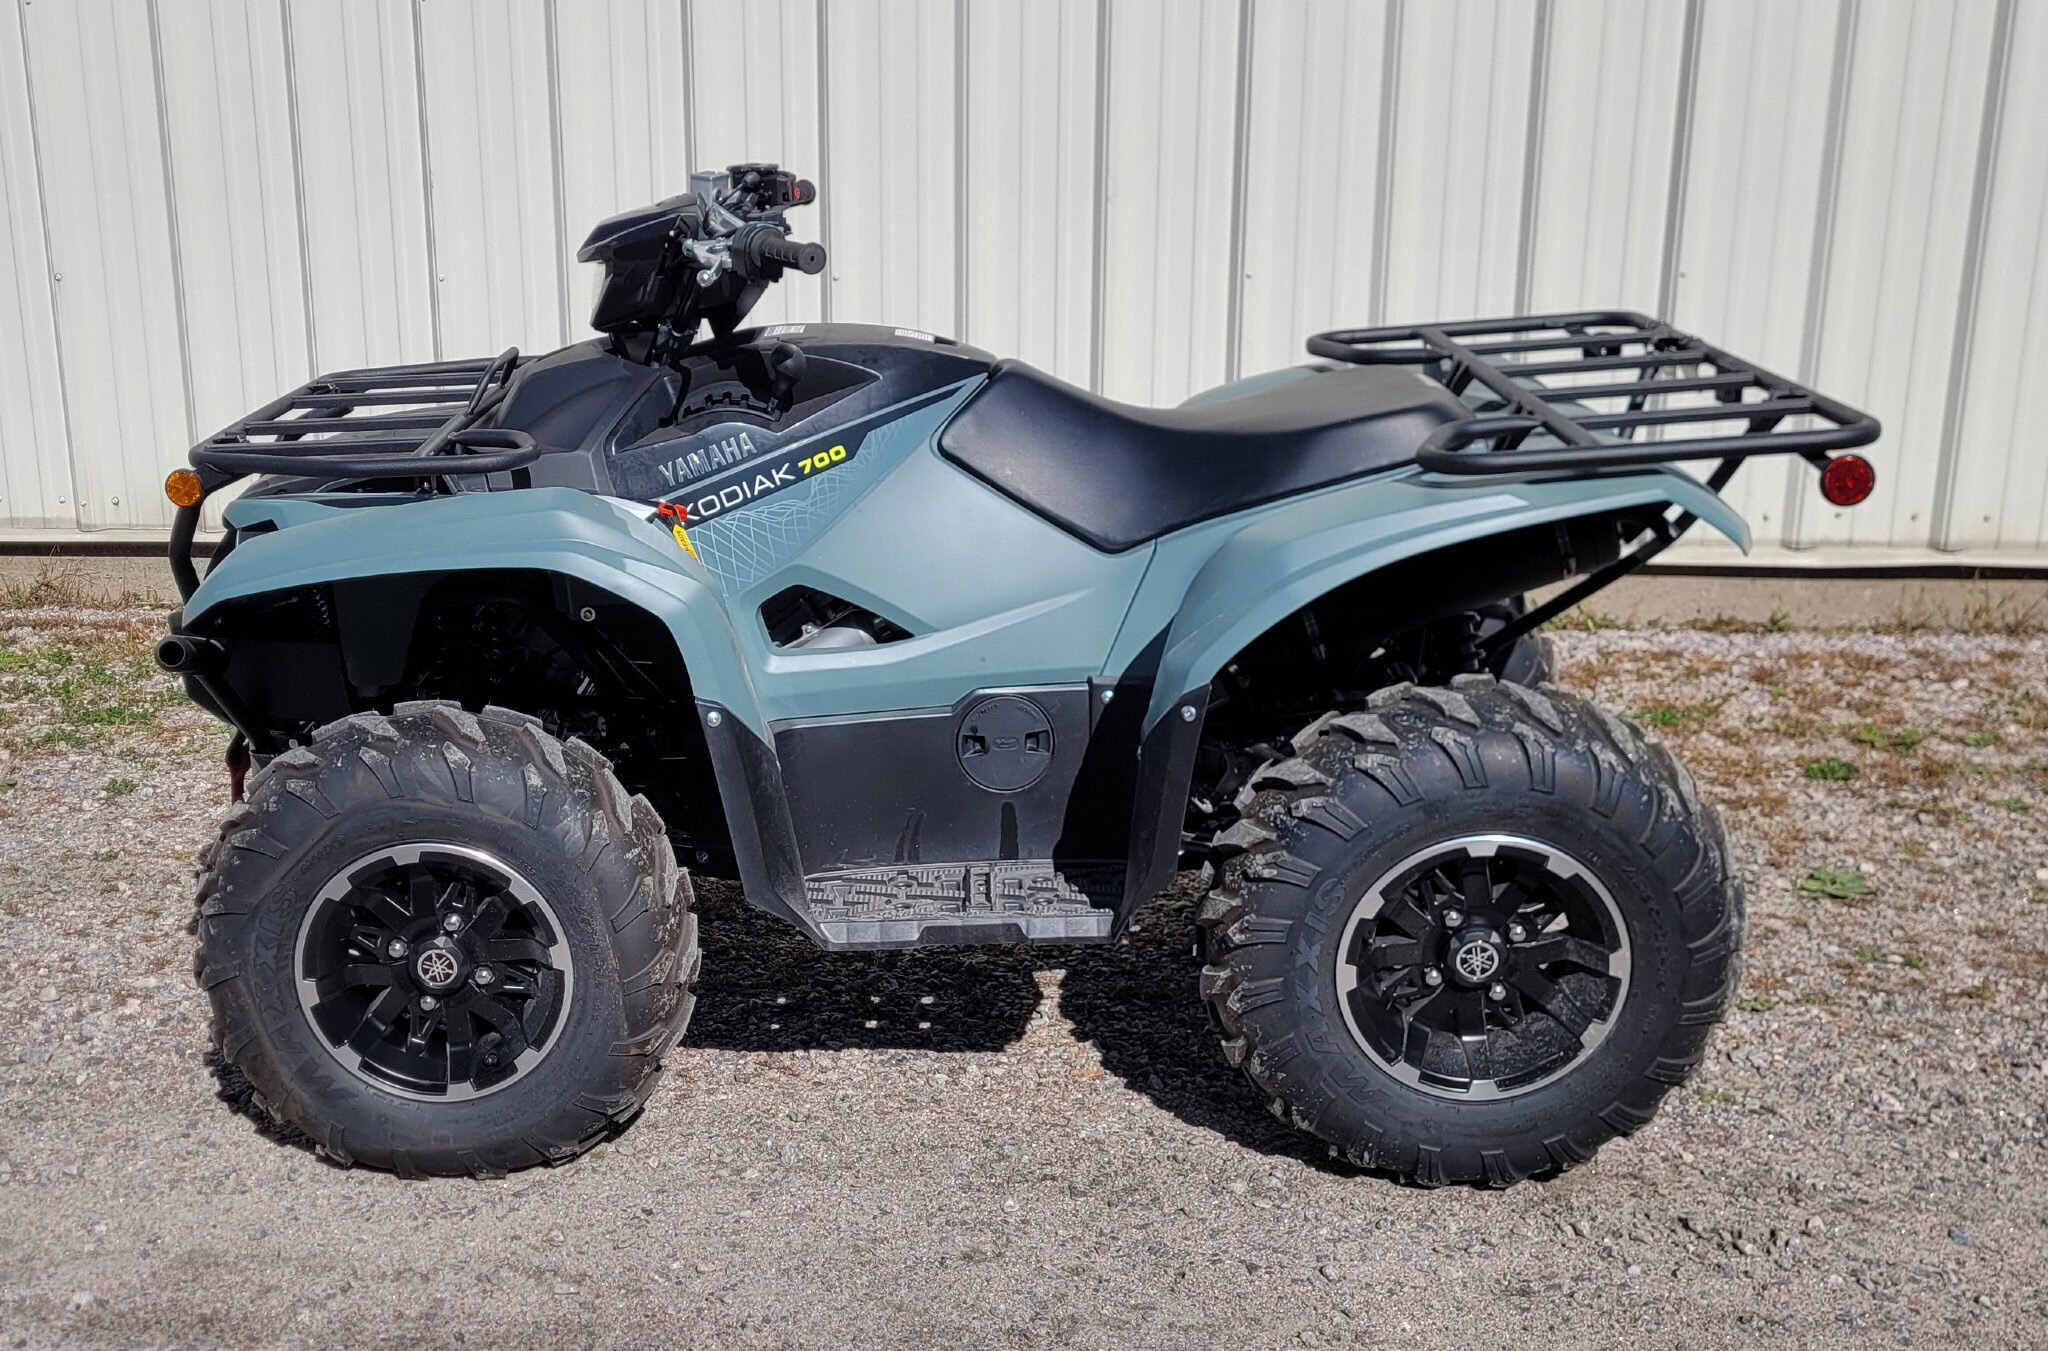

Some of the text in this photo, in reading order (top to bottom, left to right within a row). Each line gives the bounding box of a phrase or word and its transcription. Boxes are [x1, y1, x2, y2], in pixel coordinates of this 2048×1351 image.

[658, 431, 757, 487] YAMAHA
[798, 444, 847, 475] 700
[675, 529, 691, 552] READY
[252, 882, 359, 1104] MAXXIS
[1296, 878, 1394, 1105] MAXXIS
